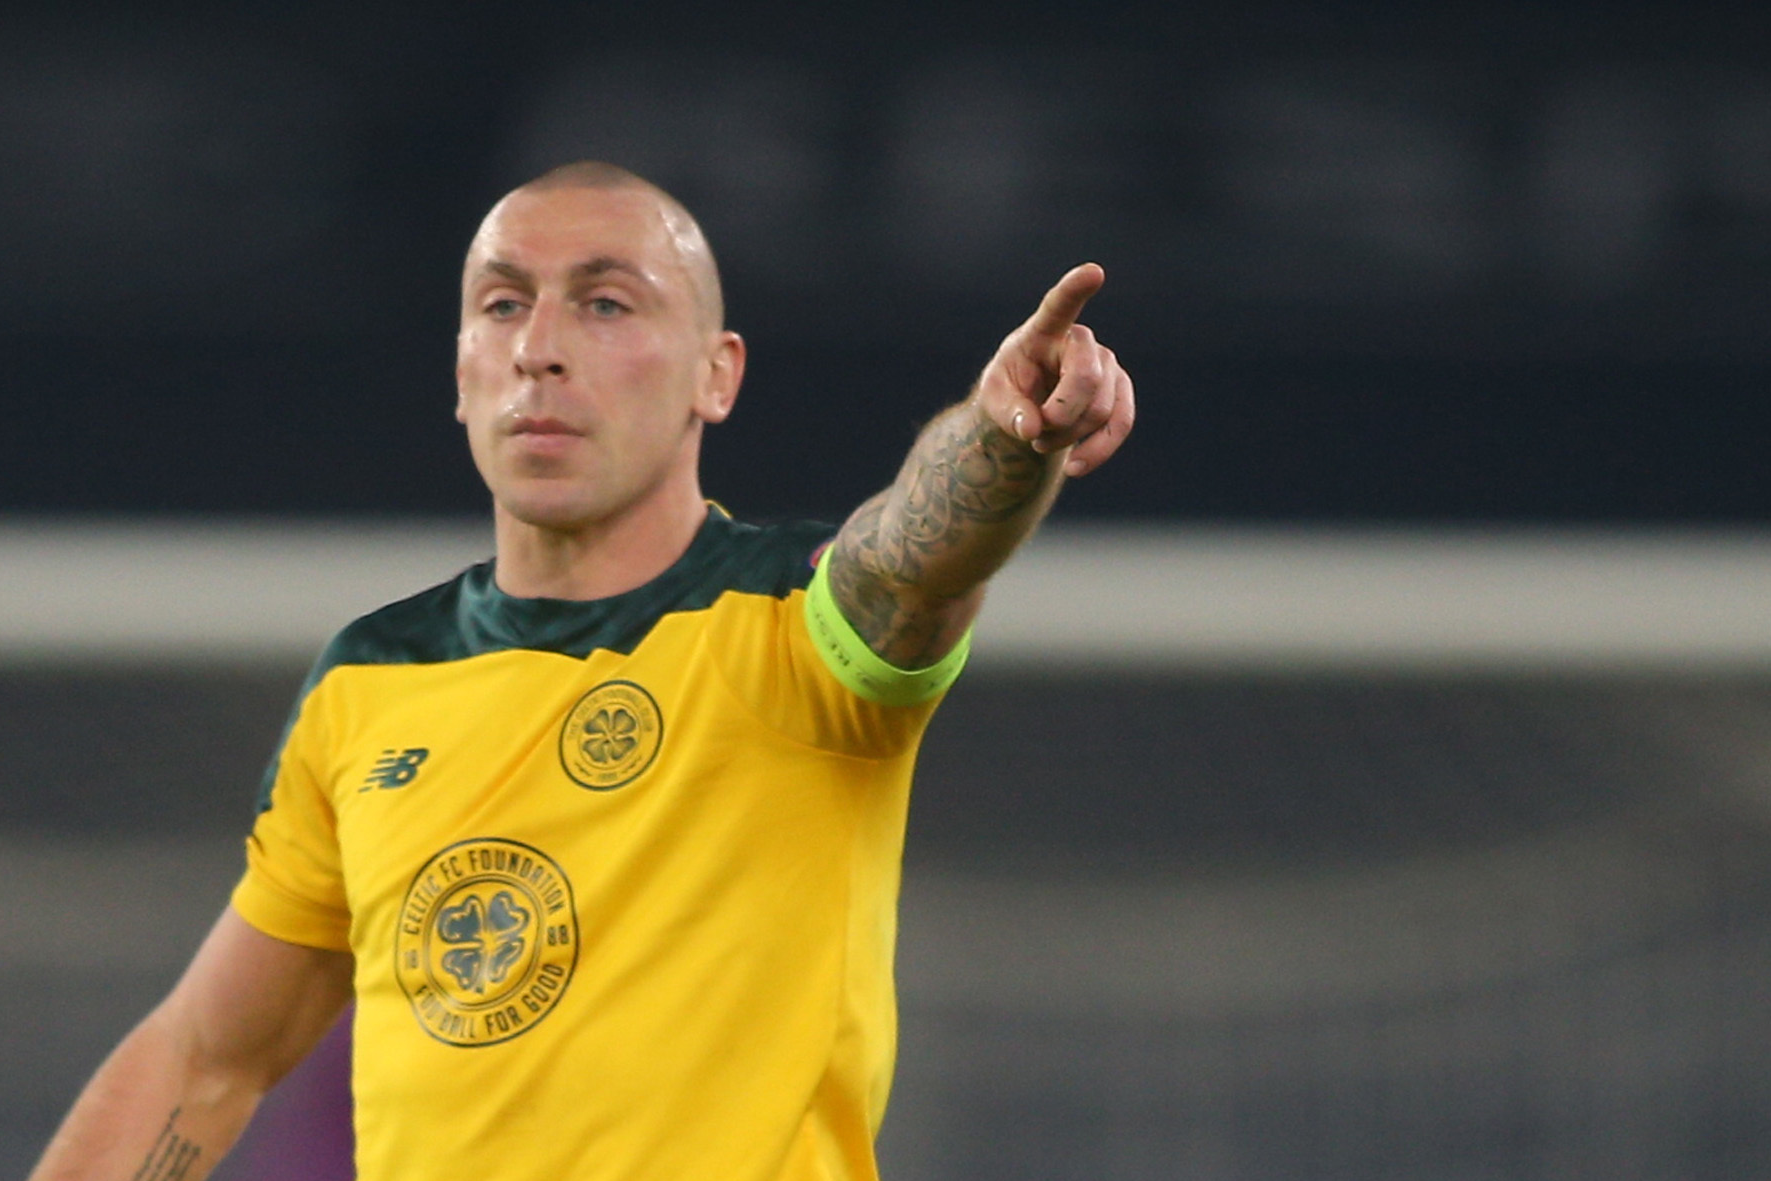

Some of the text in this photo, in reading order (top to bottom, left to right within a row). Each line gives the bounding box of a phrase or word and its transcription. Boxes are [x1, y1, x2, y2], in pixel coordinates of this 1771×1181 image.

[404, 849, 565, 935] CELTIC FC FOUNDATION
[547, 924, 570, 946] 88
[415, 963, 565, 1039] FOOBALL FOR GOOD
